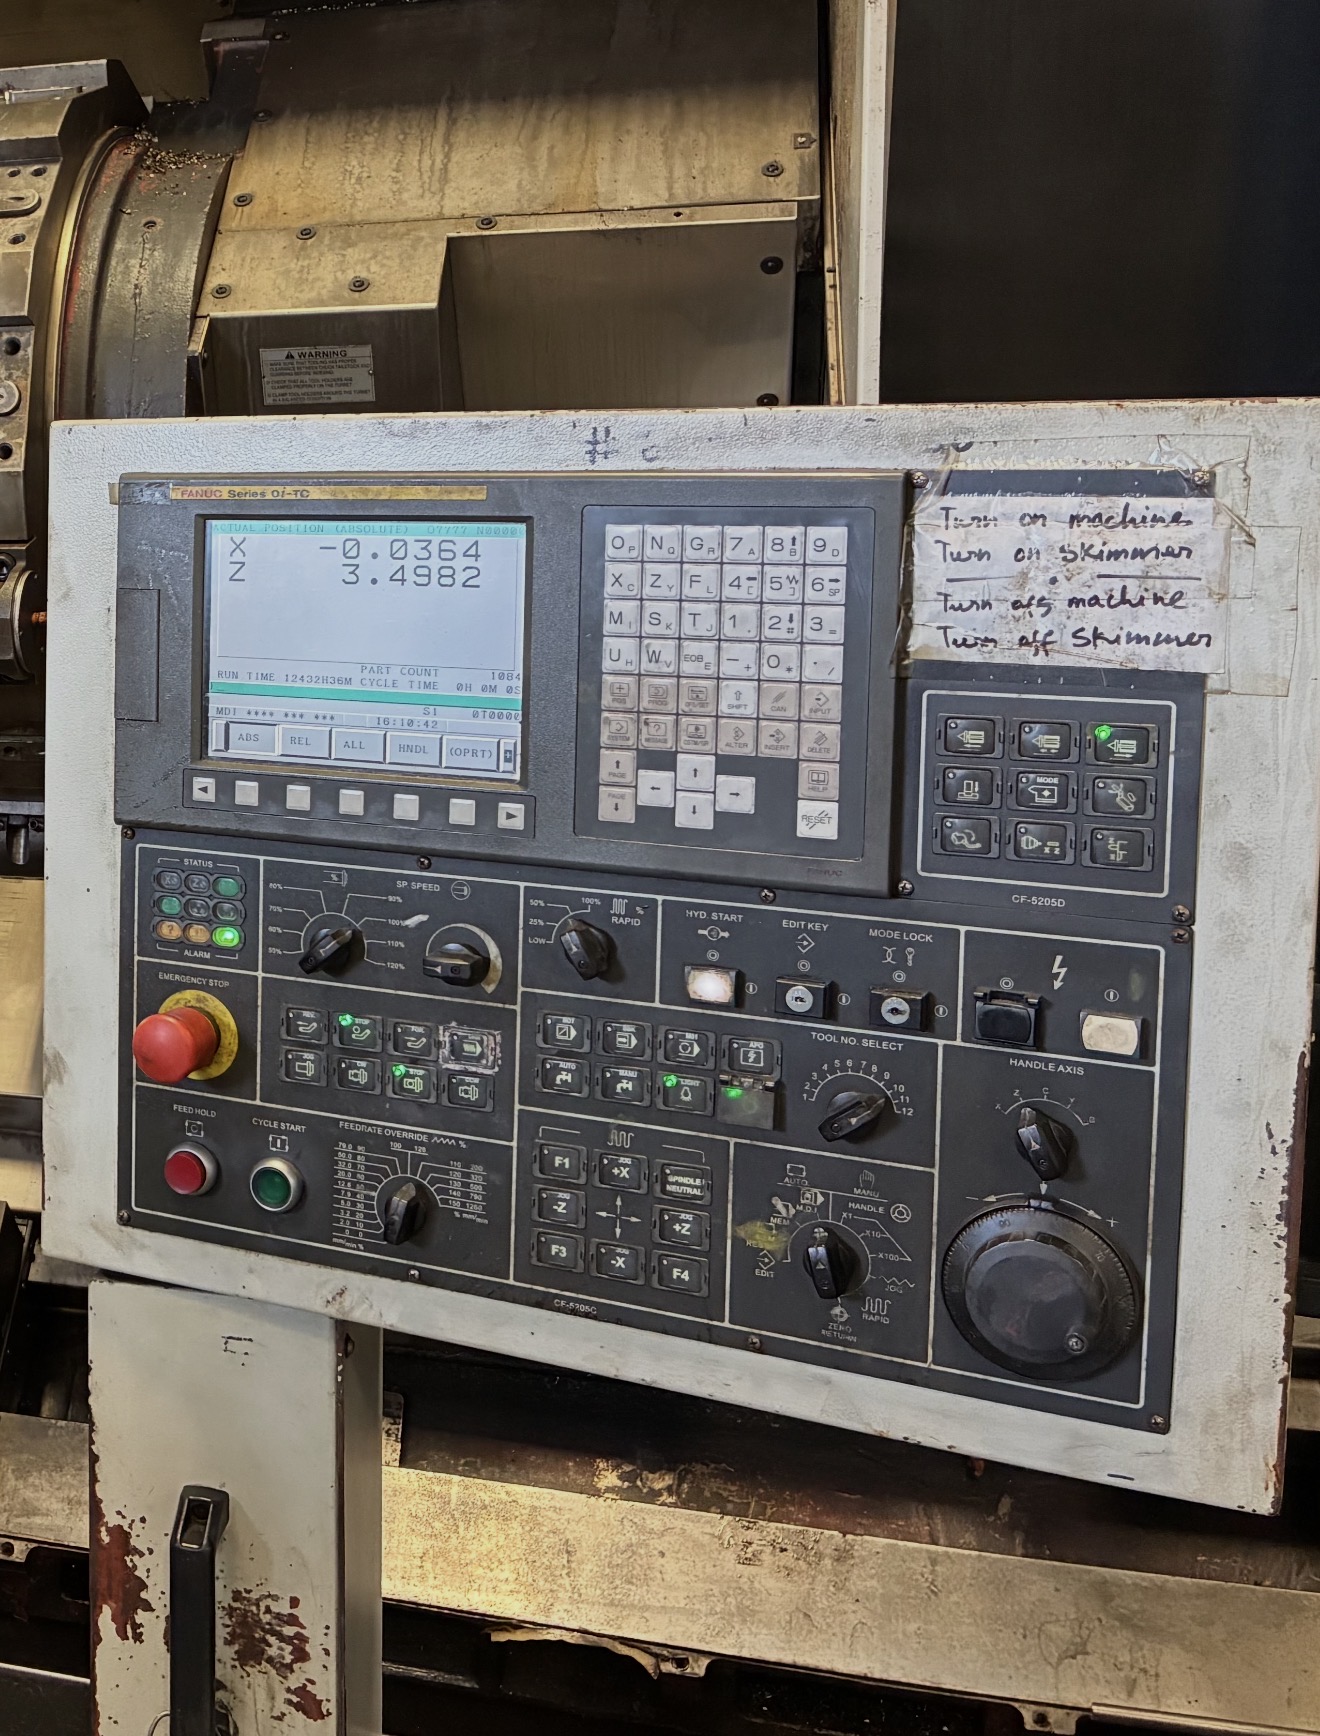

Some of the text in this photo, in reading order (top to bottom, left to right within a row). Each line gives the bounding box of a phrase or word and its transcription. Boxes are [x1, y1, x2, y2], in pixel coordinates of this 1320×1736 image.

[297, 350, 347, 359] WARNING
[180, 489, 223, 498] FANUC
[227, 489, 266, 498] Series
[939, 502, 1193, 530] Turn on machine
[213, 524, 255, 532] ACTUAL
[264, 524, 324, 533] POSITION
[335, 524, 408, 533] (ABSOLUTE)
[230, 537, 481, 562] X -0.0364
[651, 536, 663, 550] N
[690, 537, 704, 551] G
[730, 537, 743, 551] 7
[771, 537, 784, 552] 8
[813, 538, 826, 552] 9
[934, 540, 991, 563] Turn
[1013, 546, 1041, 562] on
[229, 561, 481, 588] Z 3.4982
[611, 573, 623, 588] X
[649, 574, 662, 588] Z
[689, 574, 701, 588] F
[728, 575, 742, 590] 4
[769, 576, 783, 591] 5
[811, 577, 840, 596] 6 SP
[936, 591, 992, 613] Turn
[1067, 584, 1187, 610] machine
[609, 611, 623, 625] M
[648, 612, 662, 626] S
[688, 612, 701, 627] T
[728, 615, 736, 628] 1
[768, 615, 782, 629] 2
[809, 617, 823, 631] 3
[936, 625, 998, 648] Turn
[609, 648, 621, 661] U
[647, 649, 661, 664] W
[683, 654, 711, 670] EOB E
[218, 671, 352, 685] RUN TIME 12432H36M
[361, 666, 520, 681] PART COUNT 1084
[360, 678, 520, 694] CYCLE TIME 0H 0M 0S
[216, 707, 237, 715] MDI
[771, 705, 787, 713] CAN
[377, 717, 438, 728] 16:10:42
[238, 733, 259, 742] ABS
[290, 737, 311, 746] REL
[344, 741, 365, 749] ALL
[399, 744, 428, 754] HNDL
[450, 747, 492, 759] (OPRT)
[801, 814, 832, 825] RESET
[184, 859, 213, 868] STATUS
[411, 882, 440, 892] SPEED
[581, 897, 601, 905] 100%
[1011, 895, 1066, 907] CF-5205D
[612, 916, 640, 926] RAPID
[686, 910, 743, 923] HYD. START
[782, 920, 829, 932] EDIT KEY
[869, 929, 933, 942] MODE LOCK
[387, 939, 405, 948] 110%
[184, 949, 210, 959] ALARM
[387, 962, 405, 970] 120%
[158, 972, 229, 987] EMERGENCY STOP
[811, 1032, 904, 1050] TOOL NO. SELECT
[1010, 1057, 1085, 1075] HANDLE AXIS
[173, 1104, 216, 1118] FEED HOLD
[902, 1108, 914, 1116] 12
[252, 1118, 306, 1133] CYCLE START
[339, 1121, 429, 1142] FEEDRATE OVERRIDE
[554, 1157, 570, 1168] F1
[612, 1166, 629, 1178] +X
[668, 1175, 702, 1185] SPINDLE
[666, 1184, 704, 1195] NEUTRAL
[854, 1188, 879, 1197] MANU
[553, 1202, 566, 1213] -Z
[849, 1202, 886, 1213] HANDLE
[770, 1217, 790, 1225] MEM
[673, 1223, 691, 1235] +Z
[866, 1230, 881, 1238] X10
[551, 1245, 567, 1257] F3
[878, 1252, 899, 1261] X100
[611, 1256, 625, 1268] -X
[672, 1268, 690, 1281] F4
[755, 1269, 775, 1278] EDIT
[862, 1314, 890, 1324] RAPID
